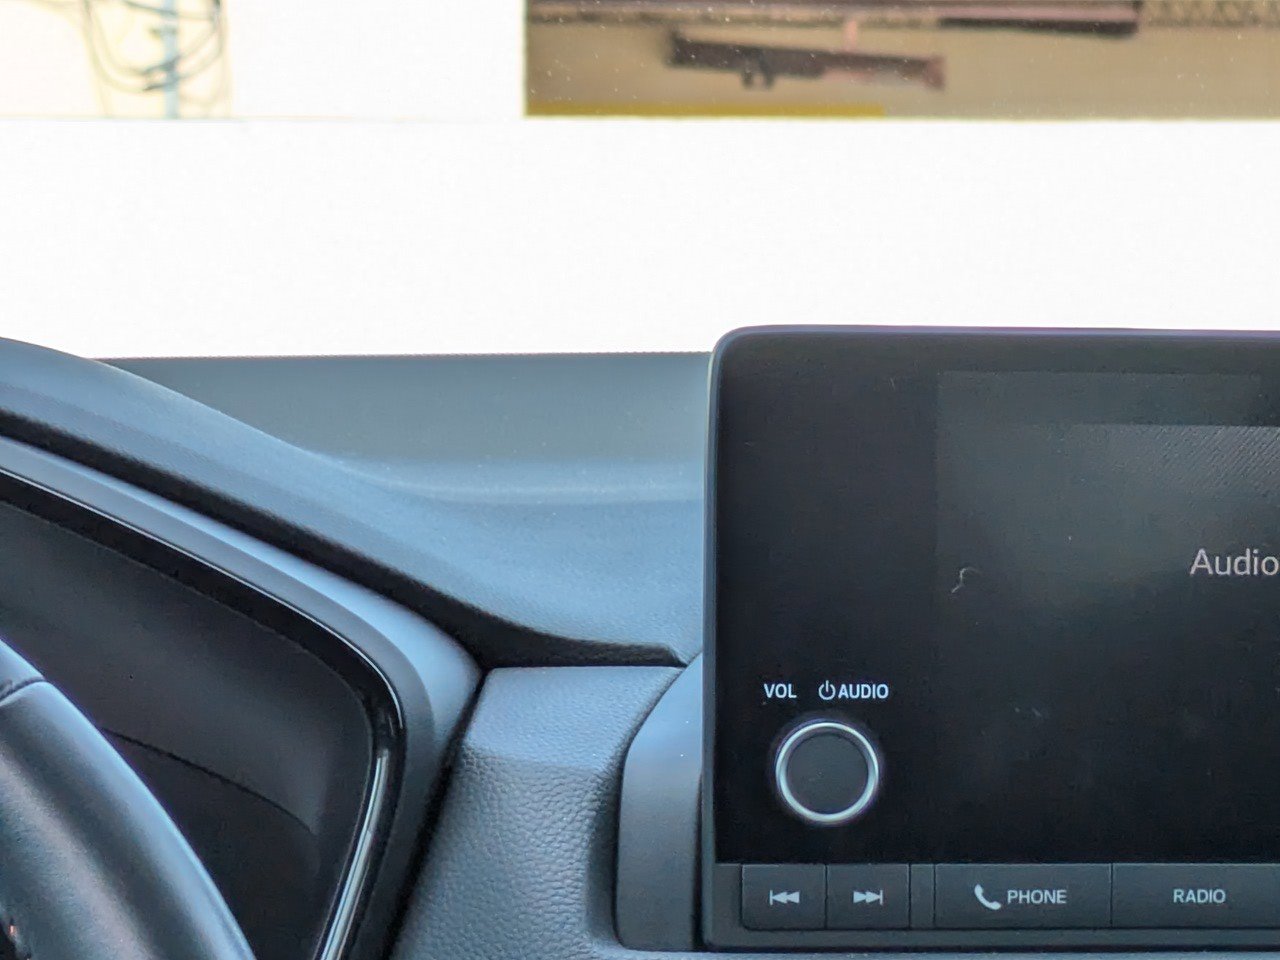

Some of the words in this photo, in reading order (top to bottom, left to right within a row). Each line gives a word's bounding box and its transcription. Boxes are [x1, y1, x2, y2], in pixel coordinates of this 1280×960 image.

[1189, 547, 1280, 577] Audio
[763, 683, 798, 699] VOL
[837, 683, 890, 699] AUDIO
[1007, 888, 1068, 905] PHONE
[1173, 888, 1227, 904] RADIO
